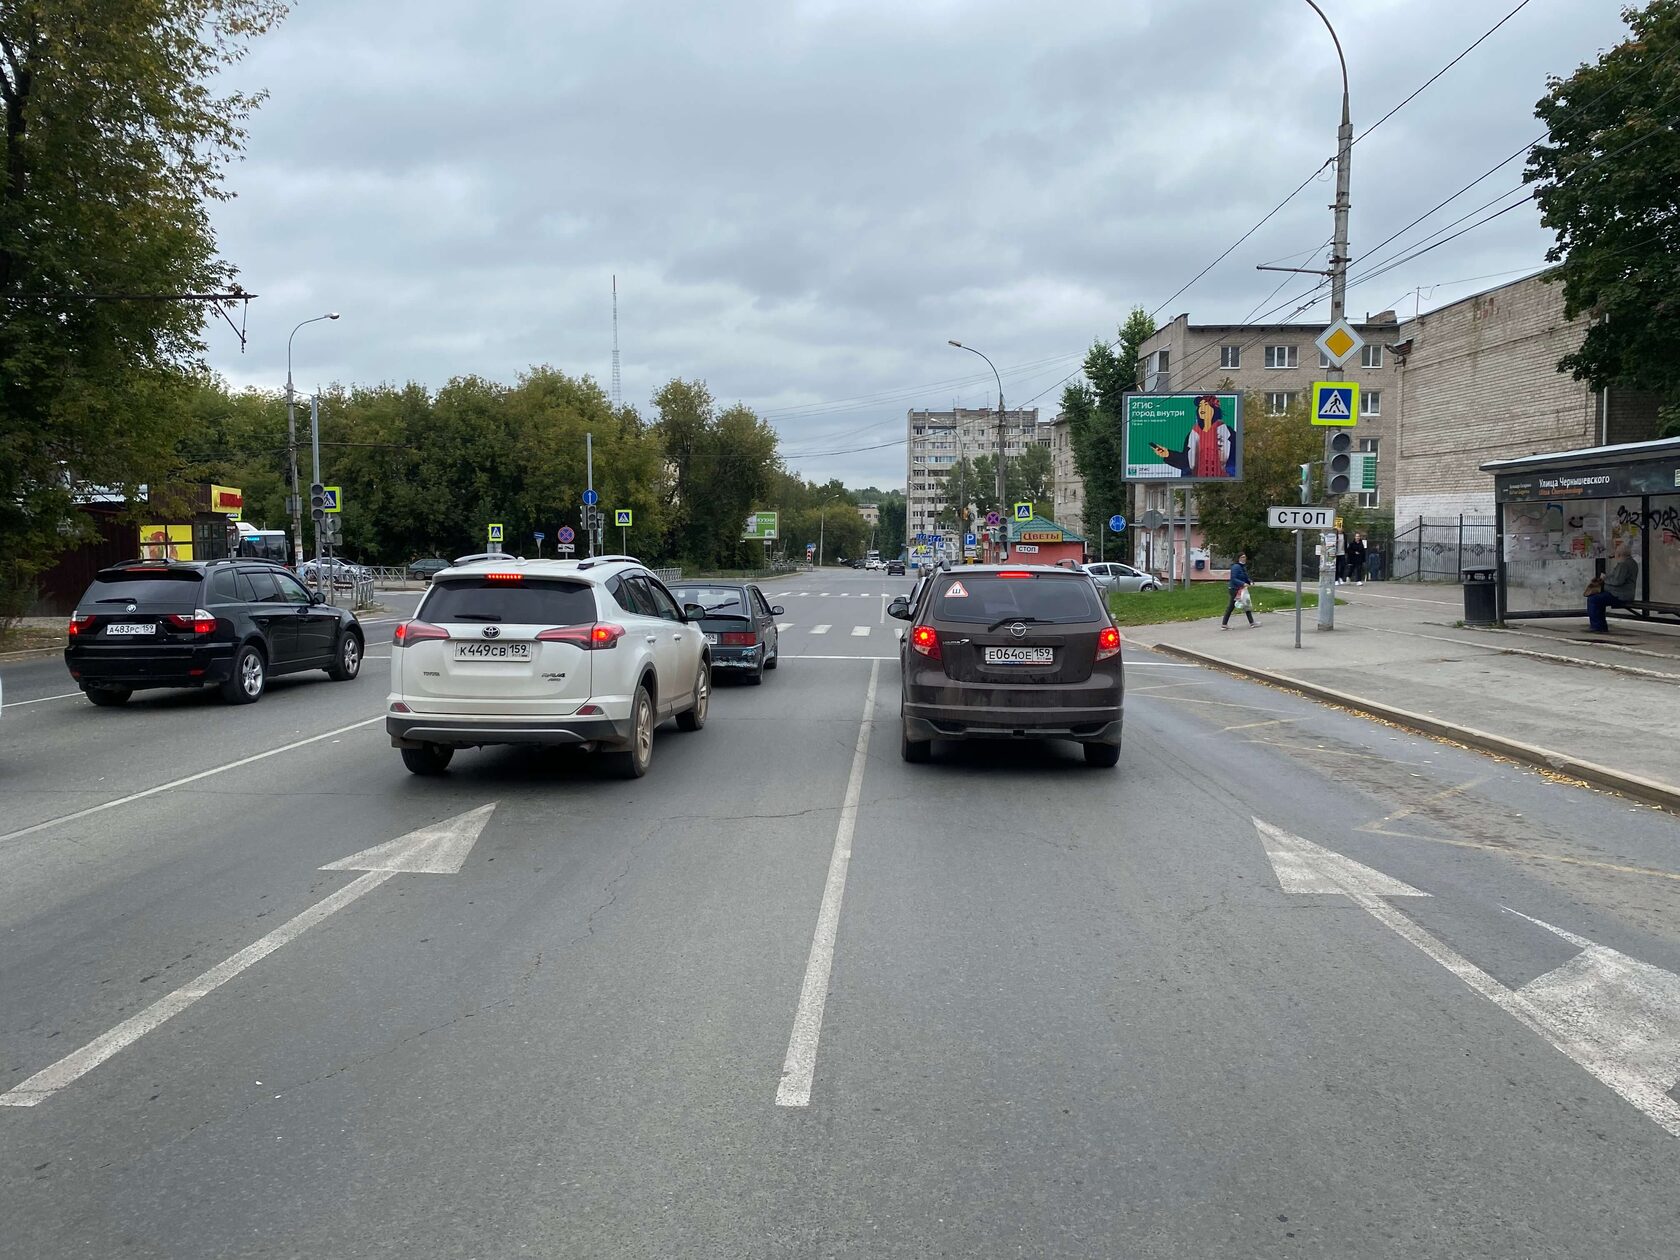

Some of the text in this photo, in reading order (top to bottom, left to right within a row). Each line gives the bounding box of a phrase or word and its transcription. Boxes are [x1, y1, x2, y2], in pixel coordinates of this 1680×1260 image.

[1132, 410, 1185, 418] город внутри
[1539, 479, 1558, 489] Улица
[1560, 475, 1610, 489] Чернышевского
[1278, 511, 1326, 524] СТОП
[966, 534, 974, 544] P
[109, 625, 140, 633] А483РС
[460, 644, 526, 657] К449СВ 159
[989, 648, 1050, 660] Е064ОЕ 159
